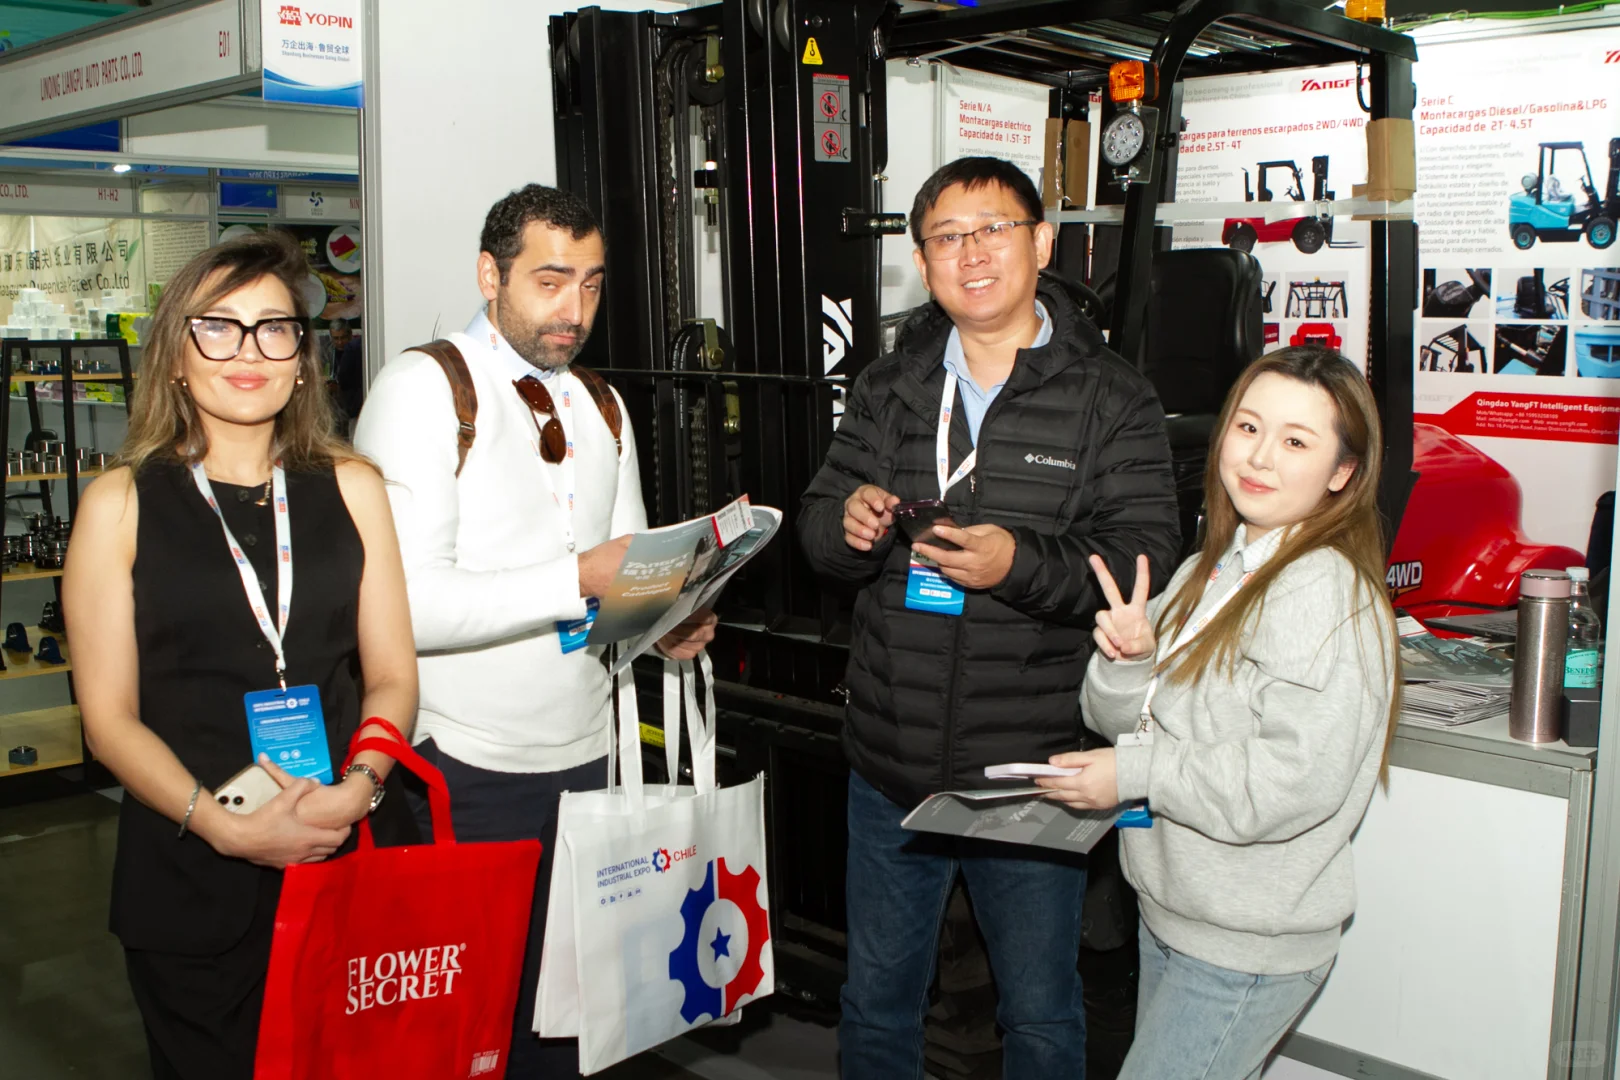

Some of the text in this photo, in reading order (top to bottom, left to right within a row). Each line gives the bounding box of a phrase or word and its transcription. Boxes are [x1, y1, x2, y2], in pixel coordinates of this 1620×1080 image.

[305, 12, 352, 29] YOPIN
[219, 30, 230, 58] E01
[85, 61, 100, 88] AUTO
[101, 57, 118, 86] PARTS
[959, 100, 992, 113] Serie N/A
[1421, 95, 1454, 107] Serie C
[959, 113, 1003, 130] Montacargas
[1420, 108, 1487, 122] Montacargas
[959, 127, 994, 141] Capacidad
[995, 132, 1003, 142] de
[1179, 131, 1206, 143] cargas
[1207, 130, 1226, 141] para
[1227, 126, 1262, 138] terrenos
[1263, 123, 1314, 136] escarpados
[1420, 120, 1472, 136] Capacidad
[1473, 121, 1486, 133] de
[1196, 142, 1205, 153] de
[97, 188, 119, 202] H1-H2
[1476, 398, 1510, 408] Qingdao
[1510, 400, 1539, 411] YangFT
[1539, 401, 1582, 412] Intelligent
[1034, 454, 1077, 471] Columbia
[1385, 560, 1424, 588] 4WD
[673, 844, 697, 862] CHILE
[596, 856, 650, 879] INTERNATIONAL
[597, 866, 651, 888] INDUSTRIAL EXPO
[347, 943, 461, 988] FLOWER
[345, 968, 462, 1016] SECRET
